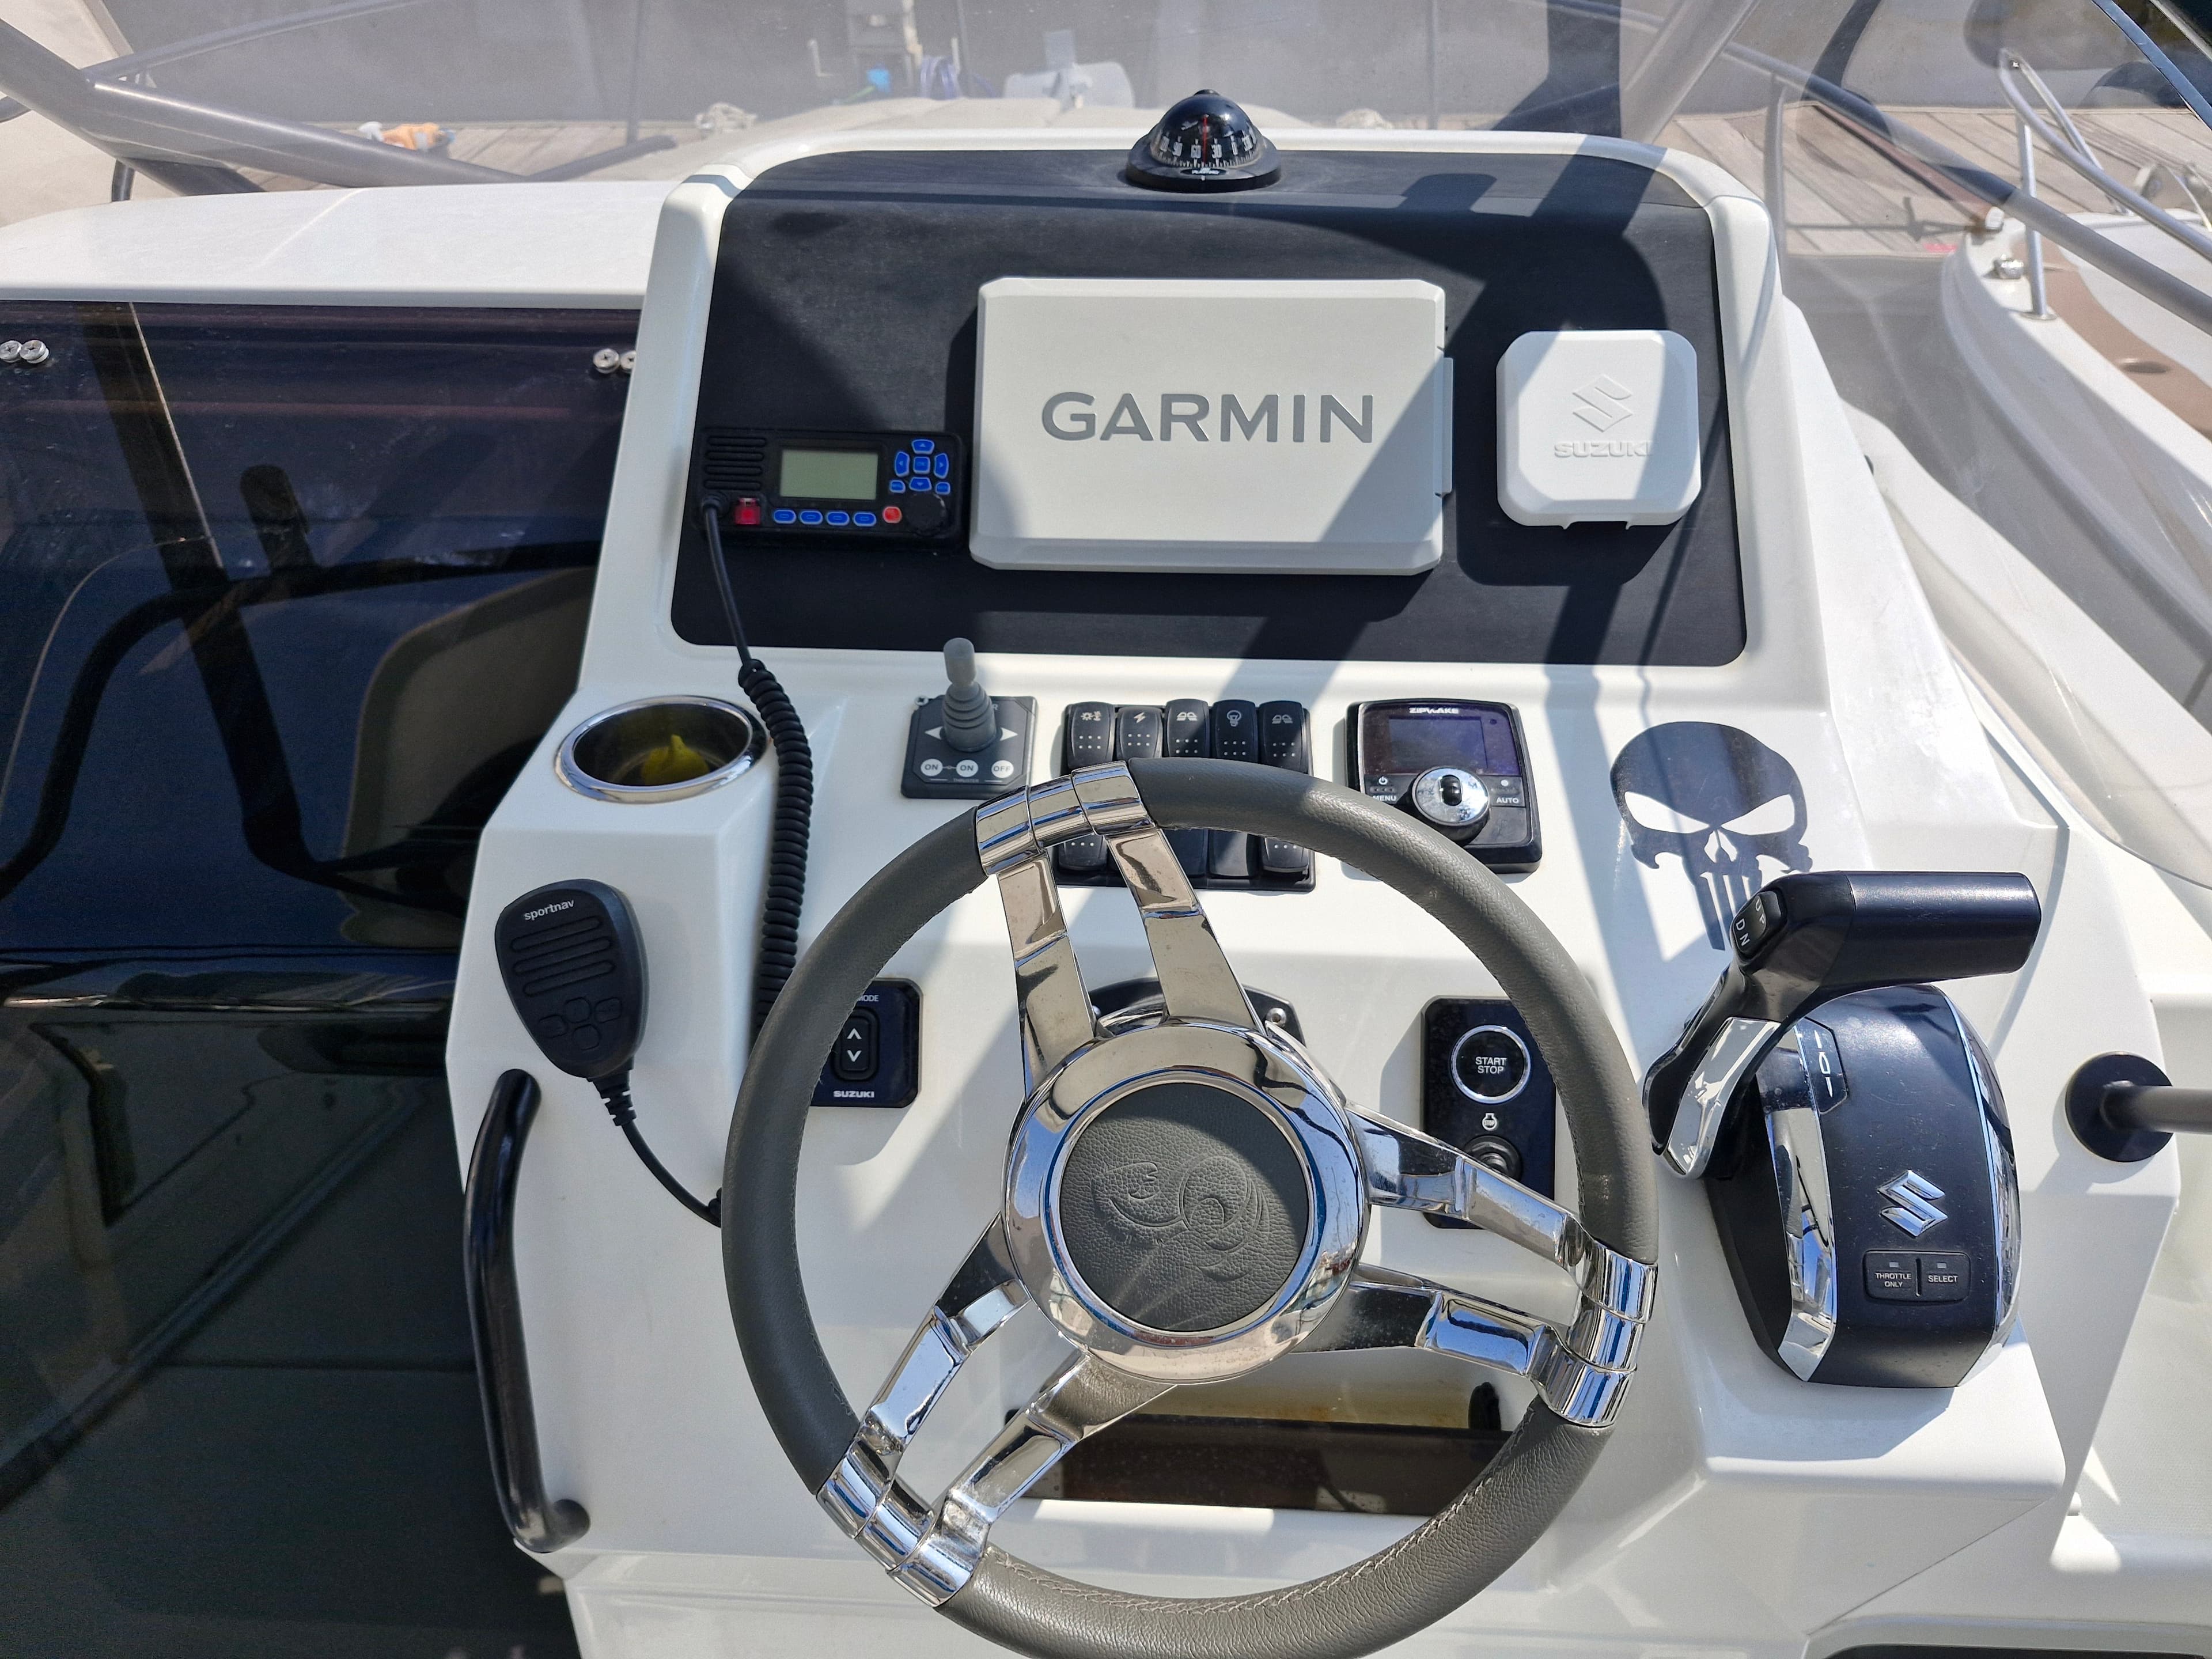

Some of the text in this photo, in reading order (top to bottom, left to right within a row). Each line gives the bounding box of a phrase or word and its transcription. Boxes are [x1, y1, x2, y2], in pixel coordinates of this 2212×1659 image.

[1173, 142, 1183, 157] 90
[1211, 144, 1222, 158] 30
[1041, 392, 1373, 443] GARMIN
[1554, 441, 1652, 457] SUZUKI
[524, 900, 574, 921] sportnav
[1475, 1056, 1507, 1065] START
[1478, 1066, 1504, 1074] STOP
[833, 1090, 875, 1099] SUZUKI
[1927, 1275, 1959, 1283] SELECT
